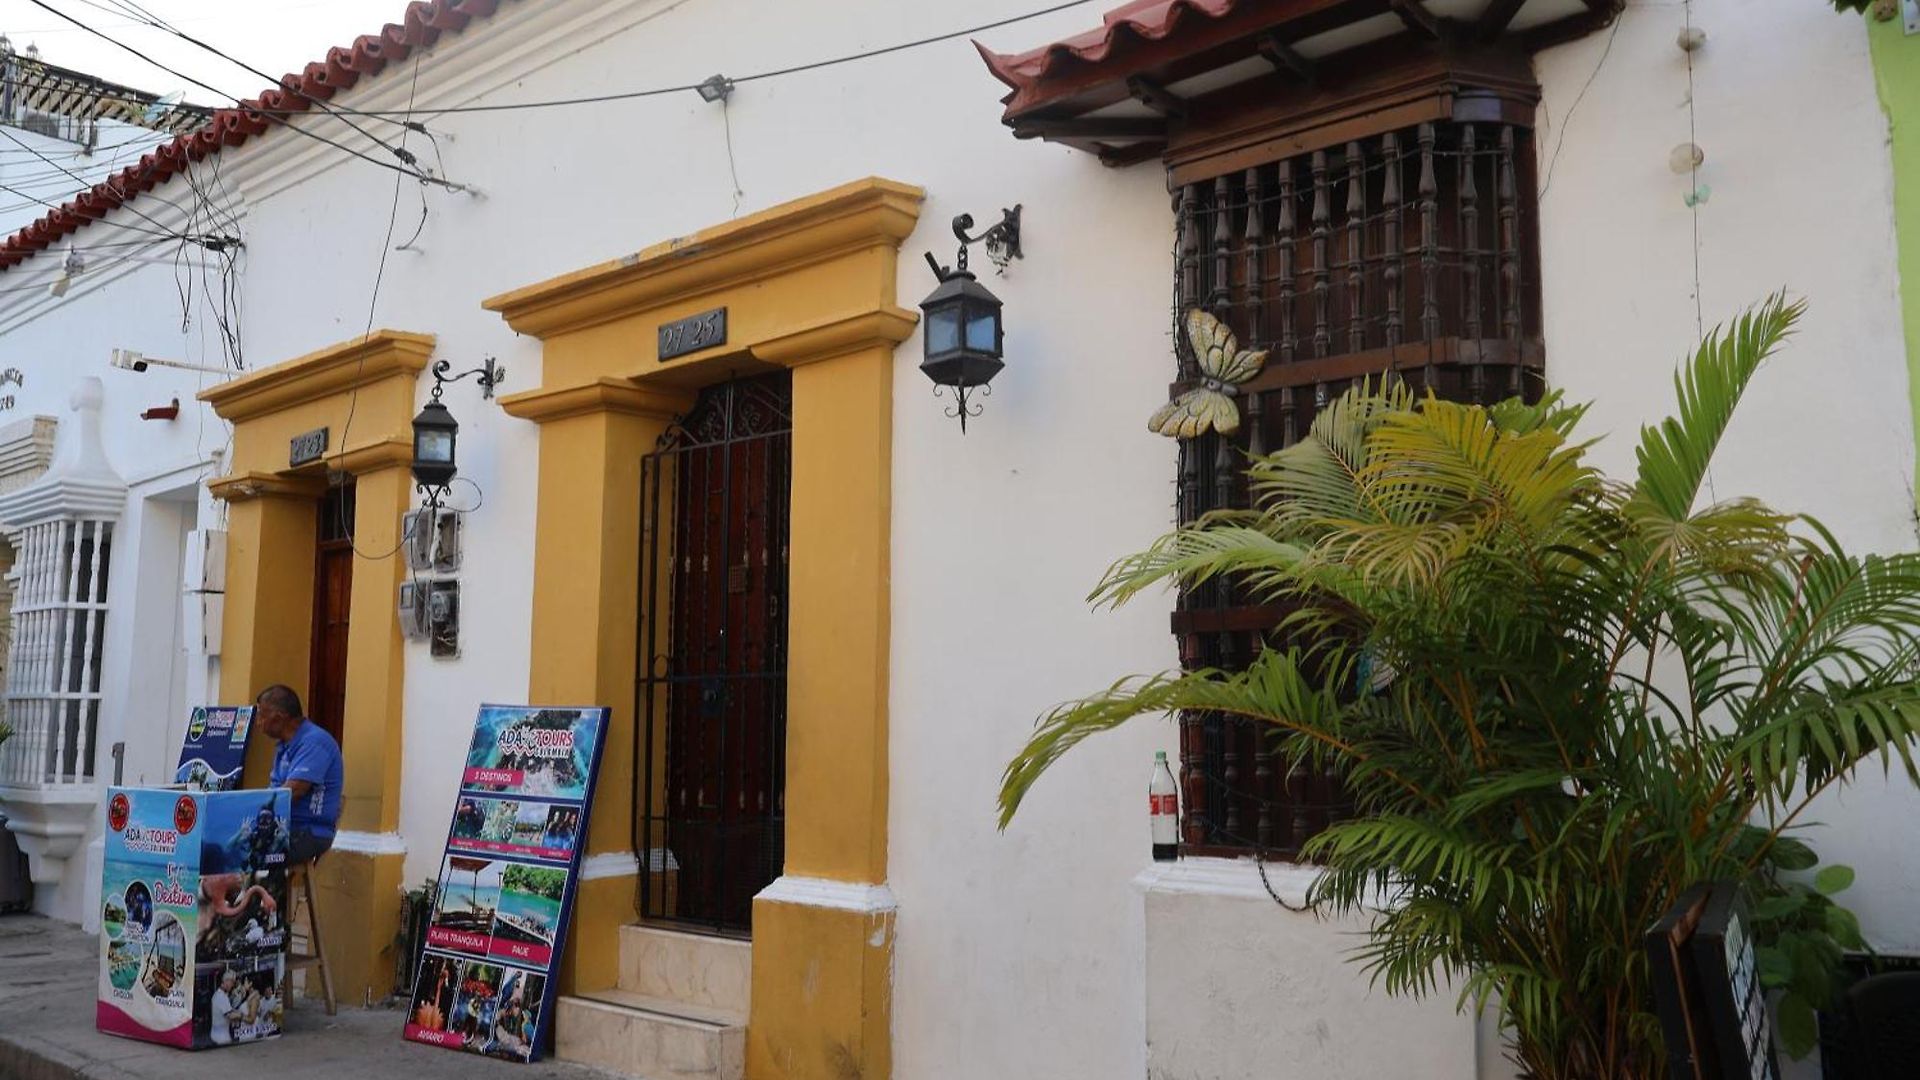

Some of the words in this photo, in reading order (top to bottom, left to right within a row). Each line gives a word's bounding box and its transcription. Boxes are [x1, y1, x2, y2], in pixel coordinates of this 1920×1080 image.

[663, 324, 686, 352] 27
[691, 313, 718, 345] 25
[534, 730, 573, 748] TOURS
[150, 830, 178, 845] TOURS
[449, 934, 485, 948] TRANQUILA
